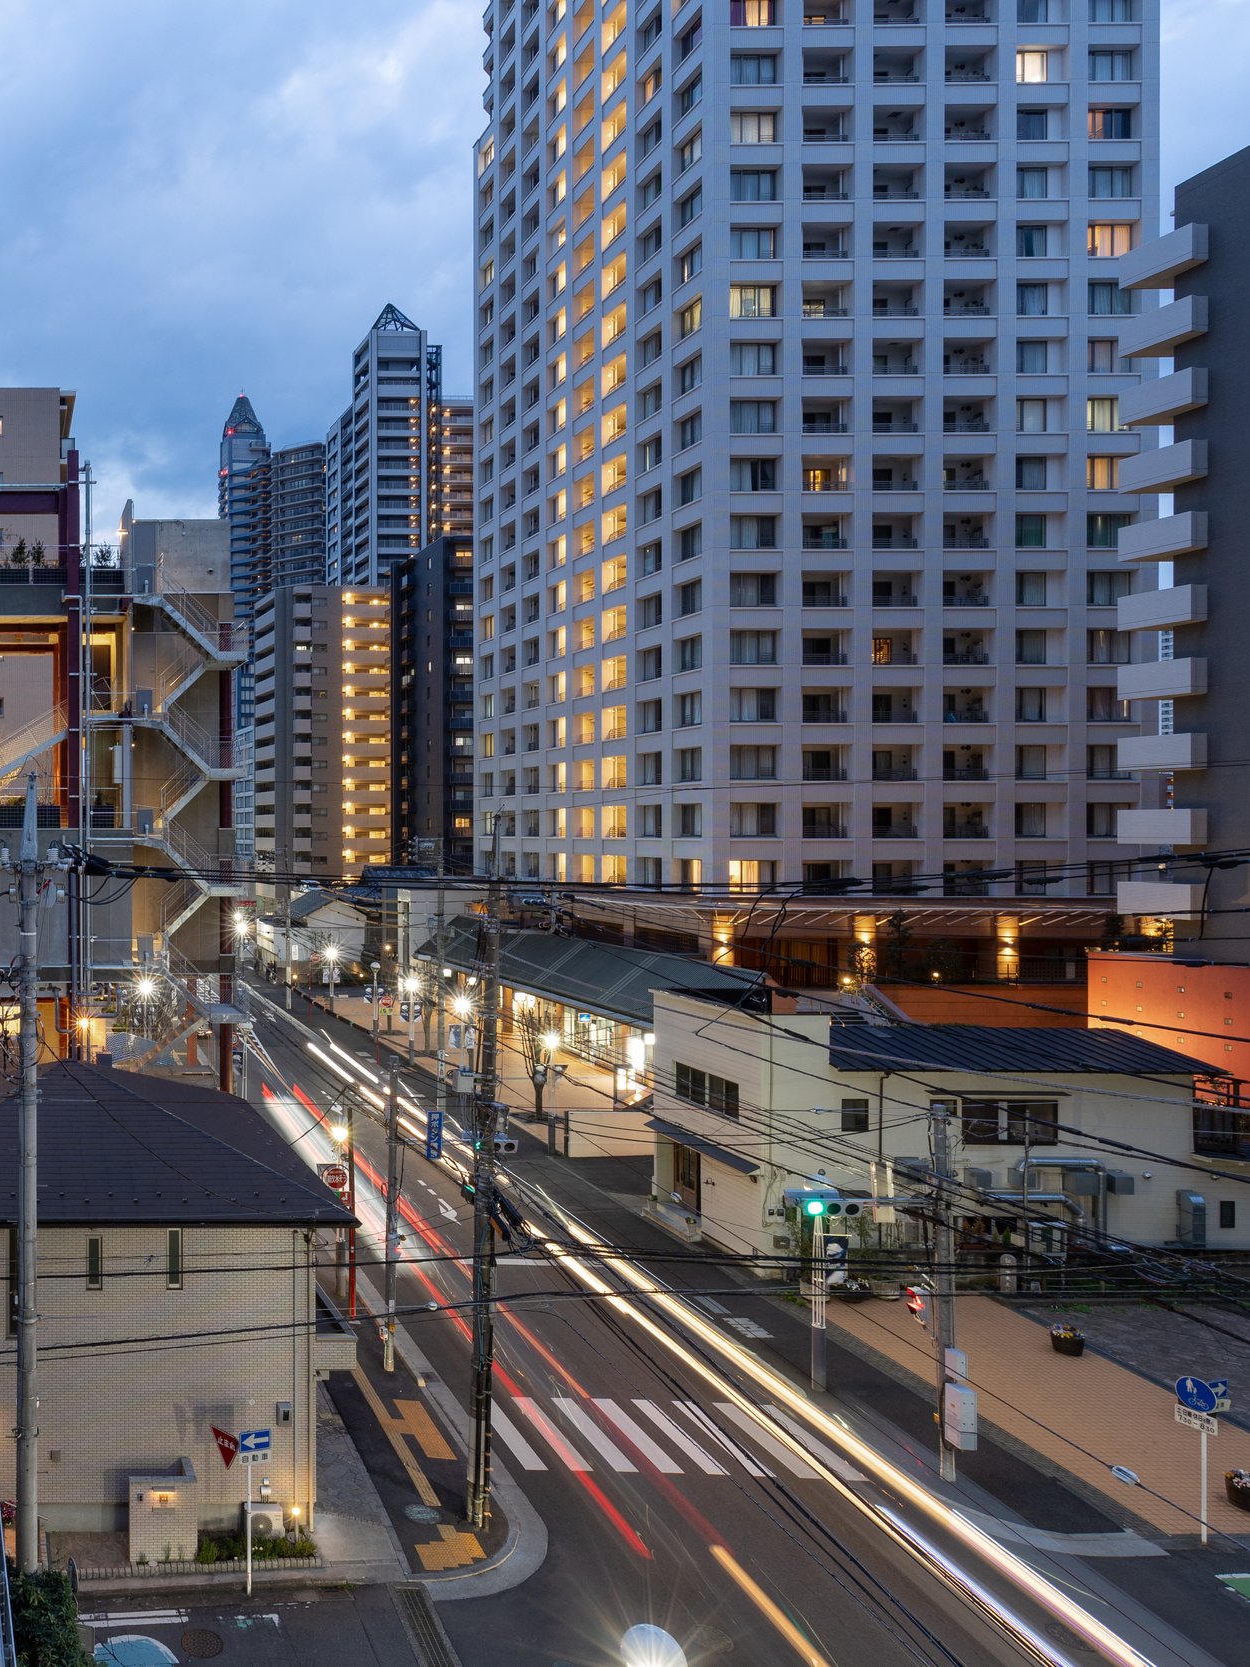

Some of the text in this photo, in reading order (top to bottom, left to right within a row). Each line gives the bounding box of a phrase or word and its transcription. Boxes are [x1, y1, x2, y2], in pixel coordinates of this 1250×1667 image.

[217, 1436, 236, 1451] 止まれ
[241, 1452, 269, 1464] 自動車
